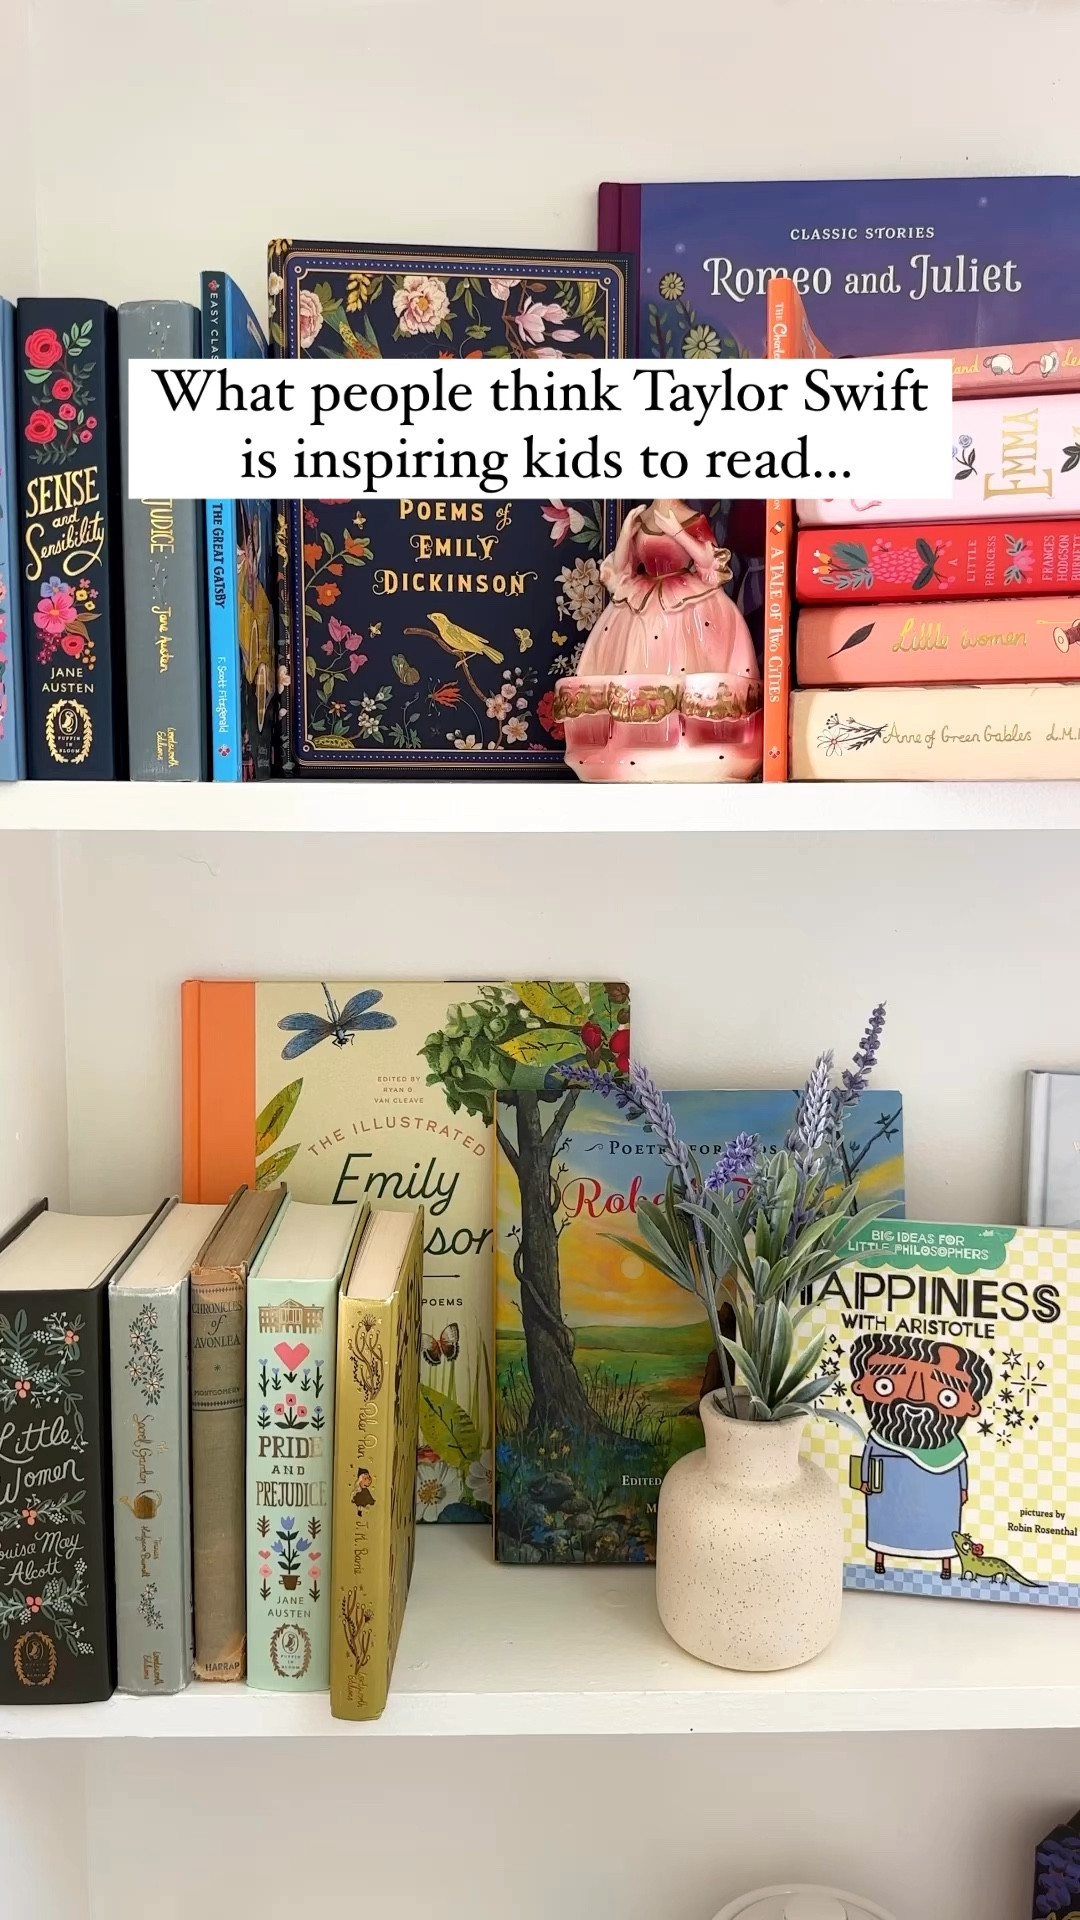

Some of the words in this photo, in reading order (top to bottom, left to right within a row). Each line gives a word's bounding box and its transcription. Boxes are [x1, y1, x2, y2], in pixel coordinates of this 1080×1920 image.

[790, 228, 858, 240] CLASSIC
[865, 227, 935, 239] STORIES
[703, 256, 832, 302] Romeo
[844, 266, 901, 294] and
[909, 254, 1022, 300] Juliet
[210, 292, 219, 325] EASY
[775, 302, 785, 321] THE
[210, 329, 219, 358] CLAS
[984, 408, 1053, 500] EMMA
[25, 466, 100, 518] SENSE
[52, 507, 80, 528] and
[141, 498, 175, 554] JUDICE
[212, 503, 224, 526] THE
[400, 498, 484, 522] POEMS
[496, 503, 512, 531] of
[25, 511, 105, 581] Sensibility
[212, 528, 225, 564] GREAT
[409, 534, 499, 562] EMILY
[771, 546, 785, 559] A
[1042, 535, 1055, 582] FRANCES
[1057, 534, 1070, 582] HODGSON
[948, 558, 958, 566] A
[967, 539, 977, 582] LITTLE
[985, 535, 997, 587] PRINCESS
[213, 566, 227, 609] GATSBY
[372, 570, 538, 596] DICKINSON
[770, 562, 785, 600] TALE
[151, 605, 172, 633] Jane
[770, 603, 783, 621] OF
[892, 617, 949, 652] Little
[155, 635, 174, 673] Austen
[218, 656, 226, 664] F.
[50, 668, 83, 679] JANE
[217, 665, 228, 688] Scott
[42, 683, 94, 693] AUSTEN
[216, 690, 230, 733] Fitzgerald
[882, 722, 922, 744] Anne
[924, 730, 936, 749] of
[941, 725, 980, 743] Green
[983, 724, 1032, 743] Gables
[307, 1128, 345, 1157] THE
[352, 1116, 486, 1157] ILLUSTRATED
[332, 1153, 460, 1217] Emily
[848, 1240, 890, 1252] LITTLE
[893, 1243, 990, 1261] PHILOSOPHERS
[871, 1229, 895, 1242] BIG
[897, 1231, 935, 1245] IDEAS
[938, 1233, 965, 1246] FOR
[192, 1301, 243, 1314] CHRONICLES
[421, 1298, 463, 1307] POEMS
[207, 1314, 228, 1336] of
[841, 1312, 888, 1331] WITH
[896, 1316, 995, 1340] ARISTOTLE
[194, 1334, 241, 1349] AVONLEA
[194, 1386, 241, 1398] MONTGOMERY
[132, 1413, 155, 1448] Secret
[358, 1401, 379, 1433] Peter
[258, 1435, 323, 1458] PRIDE
[357, 1434, 378, 1459] Pan
[132, 1447, 155, 1485] Garden
[271, 1465, 306, 1476] AND
[622, 1474, 662, 1486] EDITED
[256, 1481, 328, 1508] PREJUDICE
[1020, 1507, 1053, 1518] pictures
[1055, 1509, 1066, 1520] by
[1007, 1521, 1033, 1533] Robin
[1034, 1524, 1078, 1537] Rosenthal
[0, 1542, 36, 1561] ouisa
[34, 1530, 85, 1560] May
[4, 1556, 62, 1586] Alcott
[354, 1548, 369, 1576] Barrie
[267, 1608, 312, 1619] AUSTEN
[276, 1595, 305, 1606] JANE
[205, 1661, 241, 1672] HARRAP
